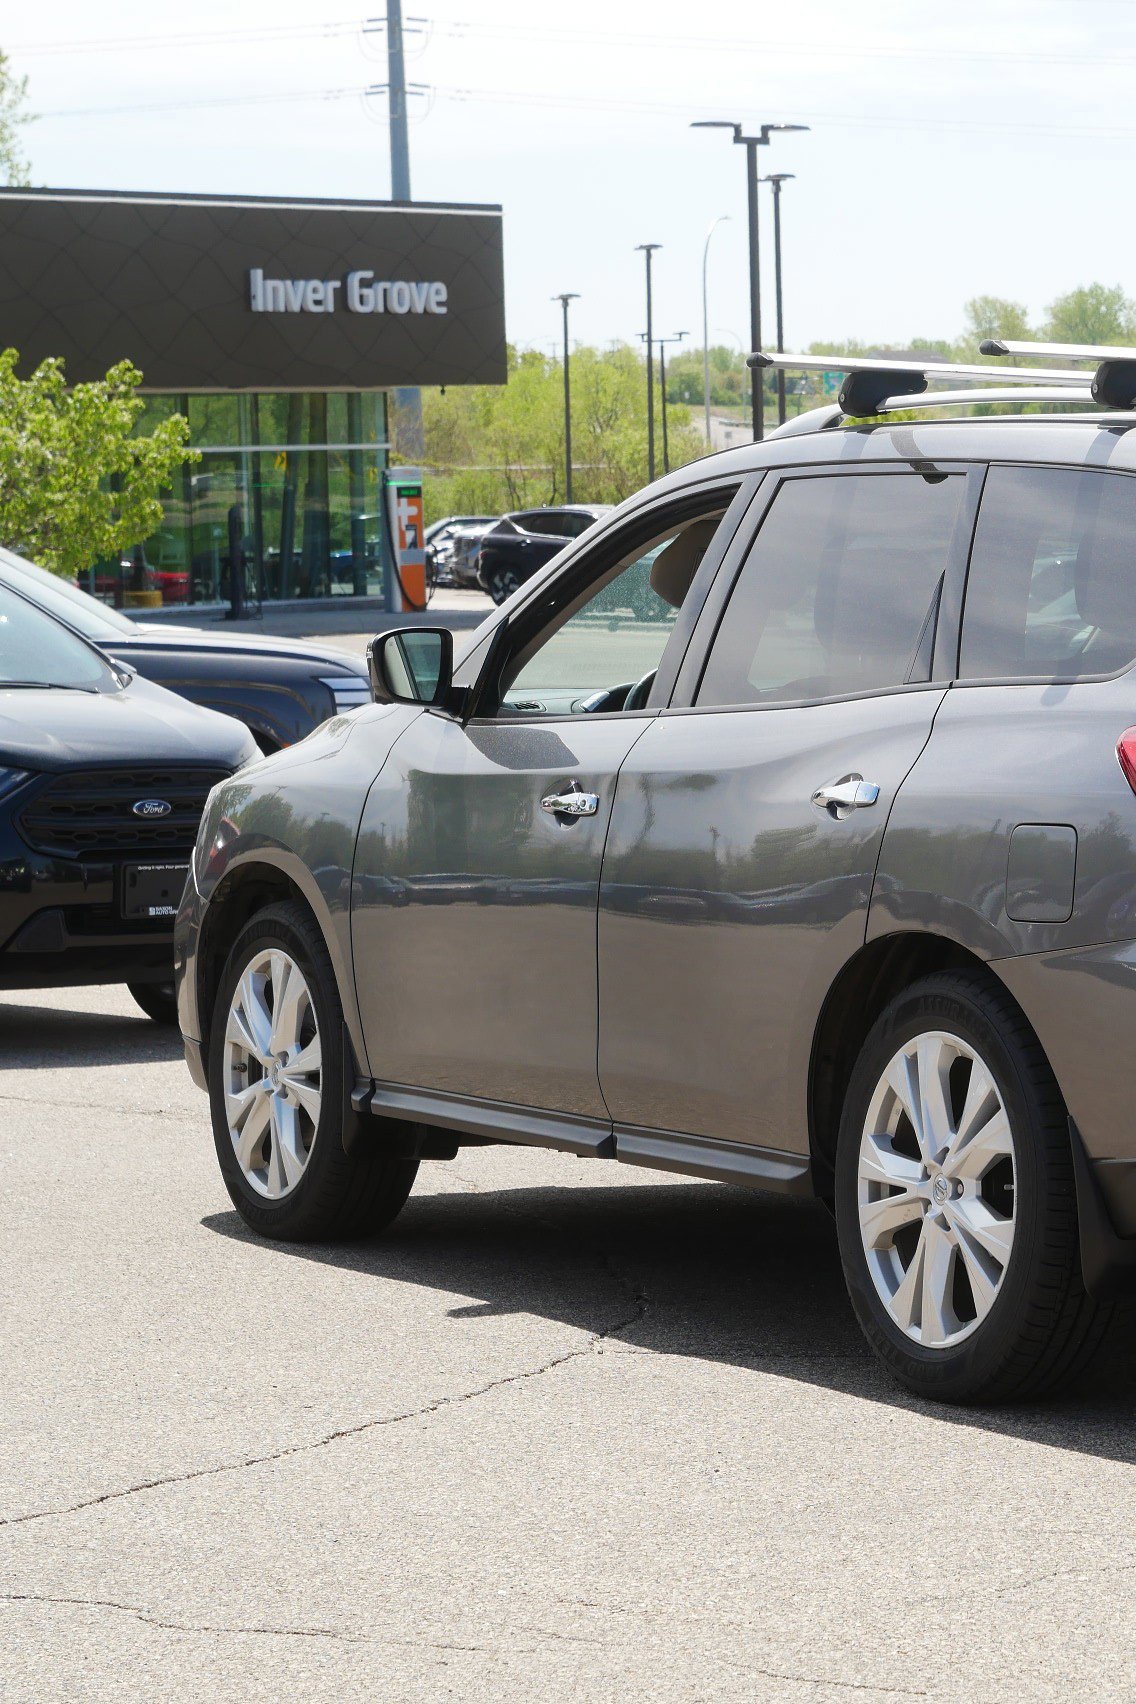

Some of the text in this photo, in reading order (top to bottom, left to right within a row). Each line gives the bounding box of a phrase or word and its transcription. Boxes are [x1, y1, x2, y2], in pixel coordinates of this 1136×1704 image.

[250, 268, 448, 314] Inver Grove
[143, 802, 164, 814] Ford
